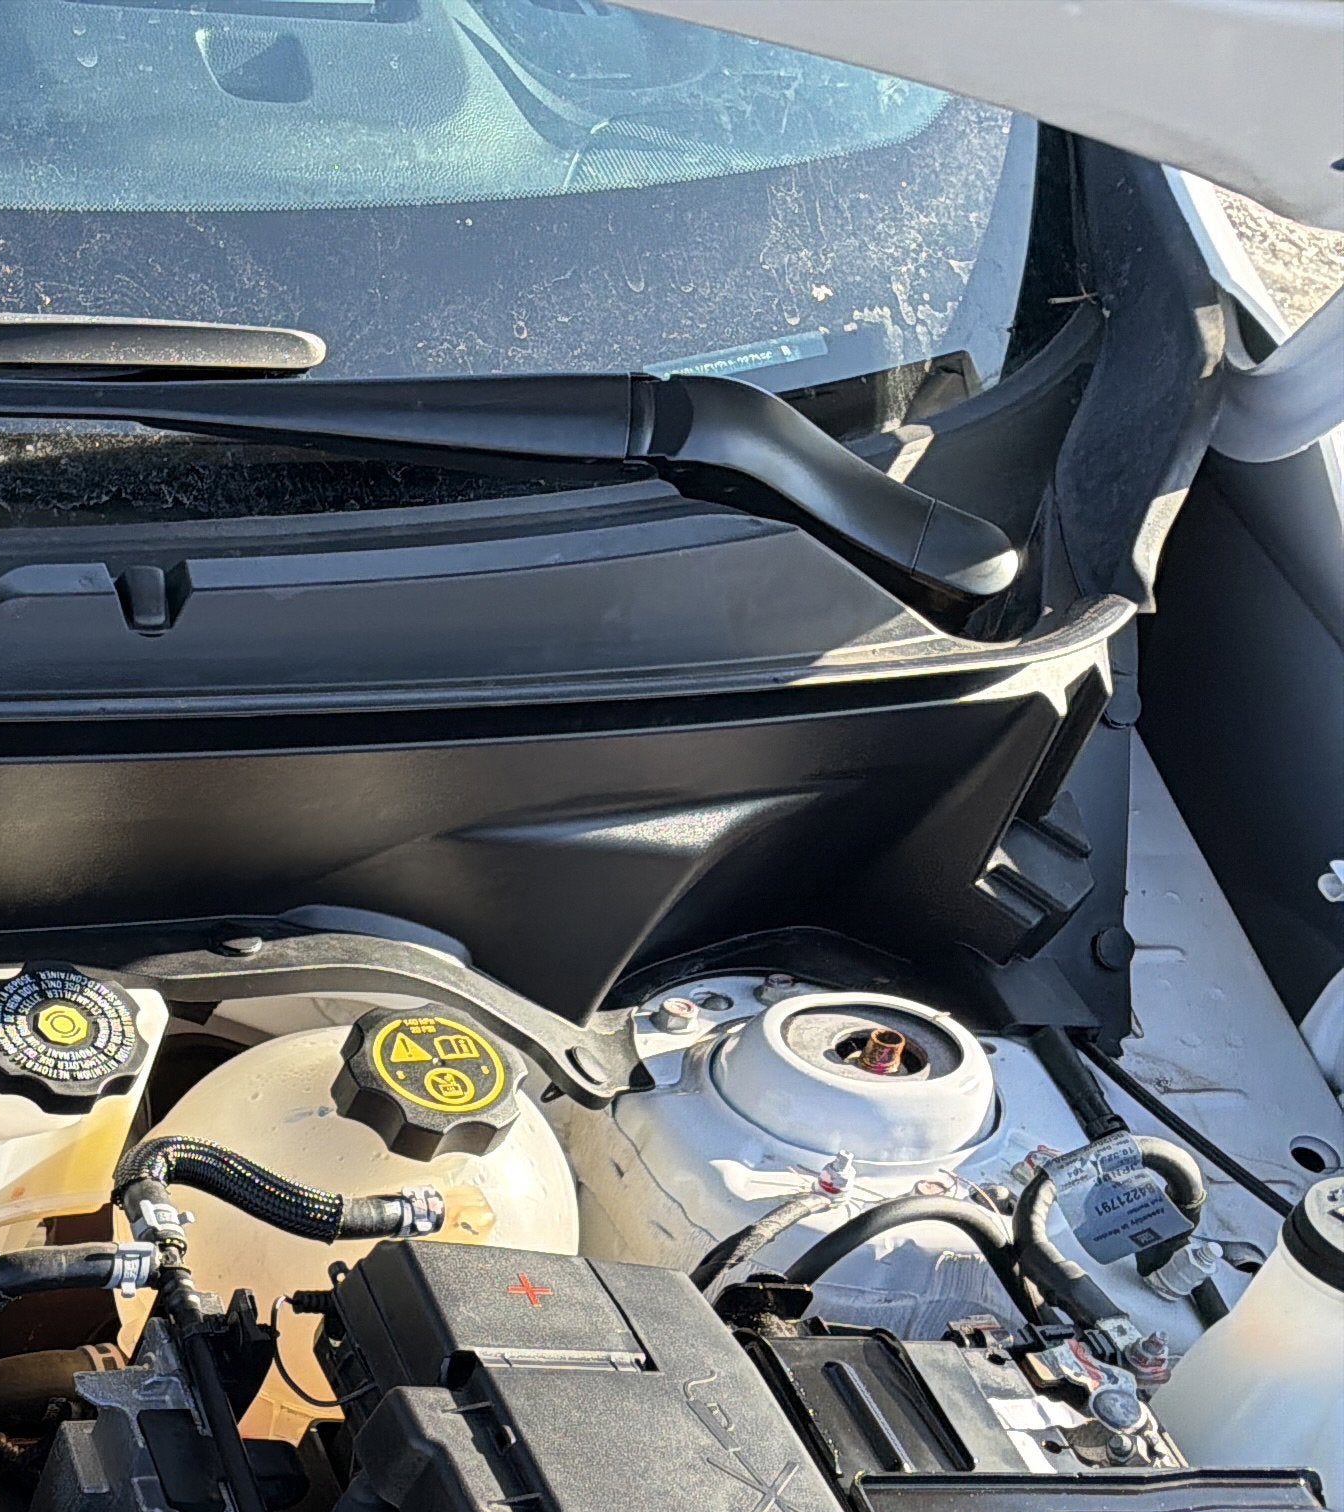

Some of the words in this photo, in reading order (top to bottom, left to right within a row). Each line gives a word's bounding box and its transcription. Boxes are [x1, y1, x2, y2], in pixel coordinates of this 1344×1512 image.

[39, 980, 61, 990] ONLY
[63, 981, 81, 991] USE
[44, 989, 77, 1000] FILLER
[1094, 1182, 1155, 1217] 84221791
